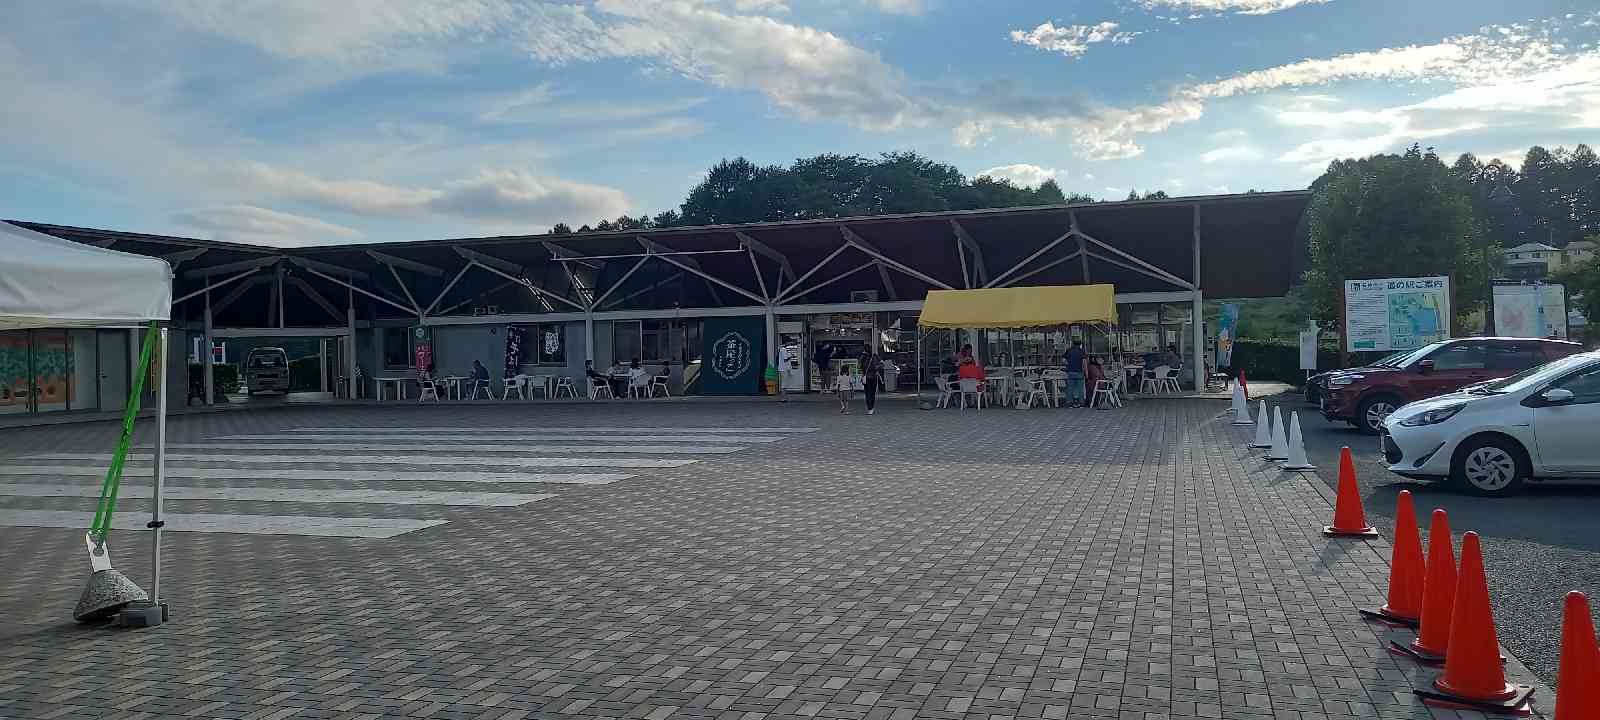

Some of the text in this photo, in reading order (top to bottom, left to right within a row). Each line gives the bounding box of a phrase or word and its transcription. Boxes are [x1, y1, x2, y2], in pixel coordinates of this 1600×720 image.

[1387, 280, 1443, 290] 道の駅ご案内
